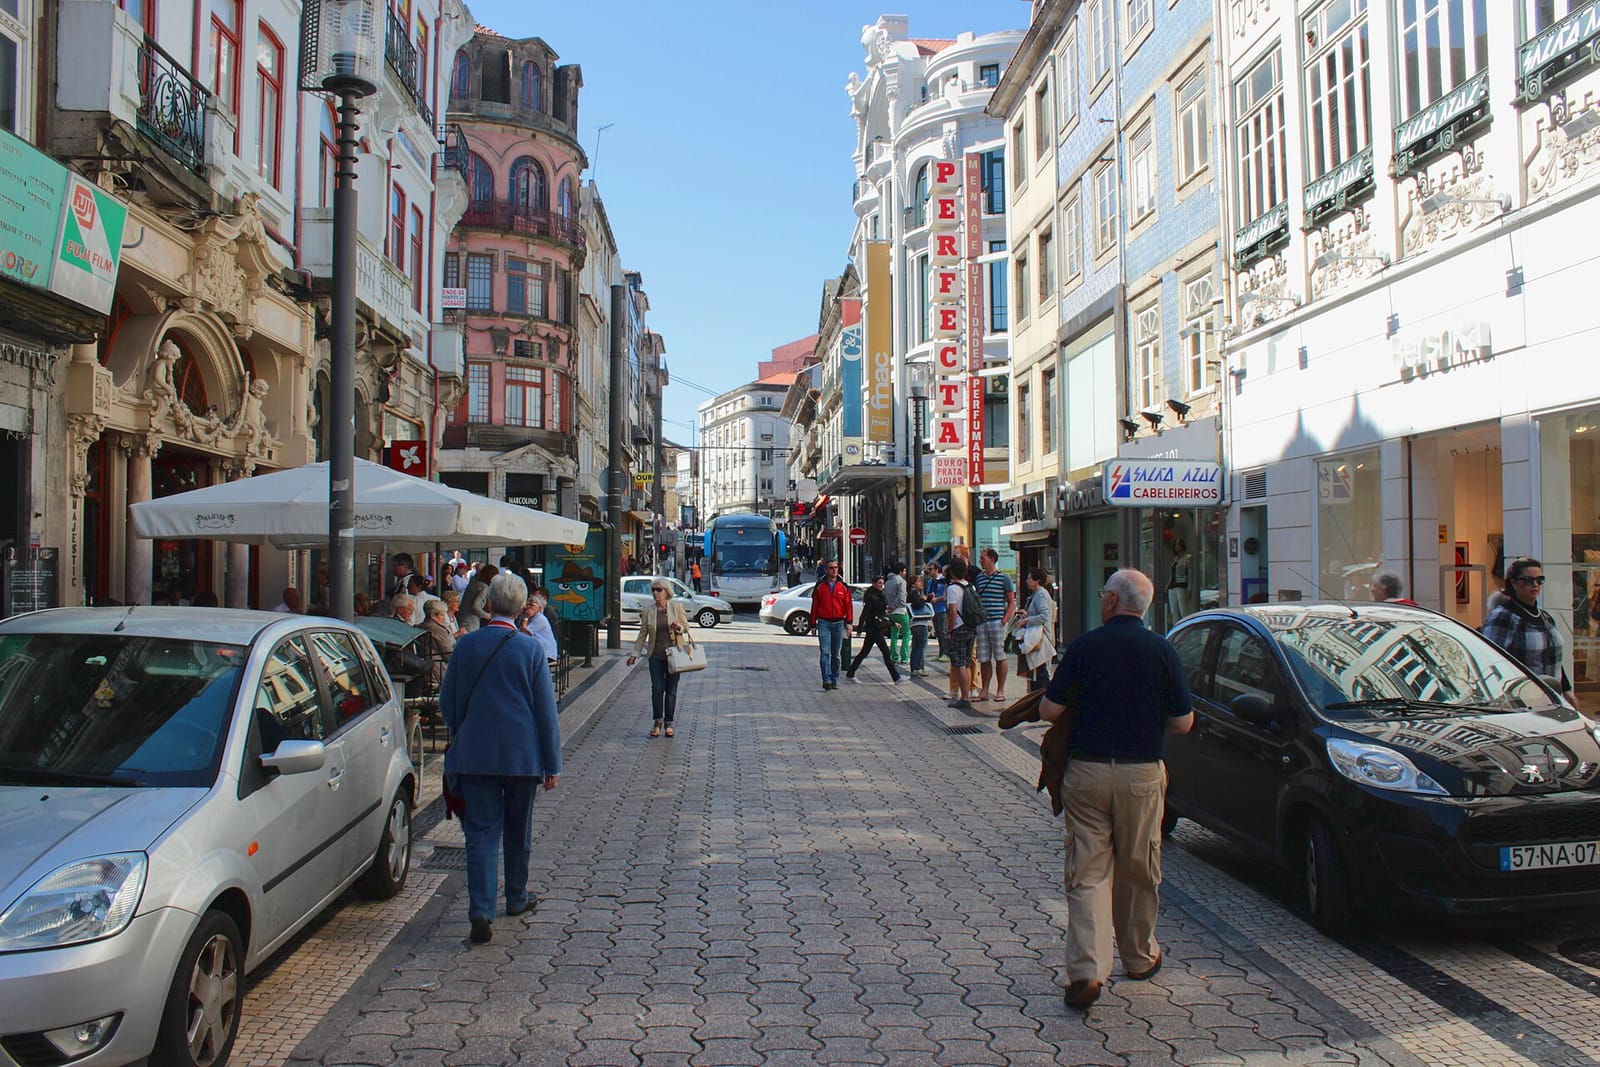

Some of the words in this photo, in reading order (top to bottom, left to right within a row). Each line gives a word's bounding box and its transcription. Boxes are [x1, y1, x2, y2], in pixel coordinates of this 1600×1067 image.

[968, 159, 978, 250] MENAGE
[65, 240, 91, 261] FUJI
[92, 252, 113, 273] FILM
[936, 162, 960, 444] PERFECTA
[971, 266, 980, 368] UTILIDADES
[870, 351, 890, 410] fnac
[972, 379, 981, 483] PERFUMARIA
[937, 459, 963, 467] OURO
[937, 468, 962, 476] PRATA
[1182, 466, 1219, 482] AZUL
[937, 477, 963, 485] JOIAS
[1133, 487, 1218, 499] CABELEIREIROS
